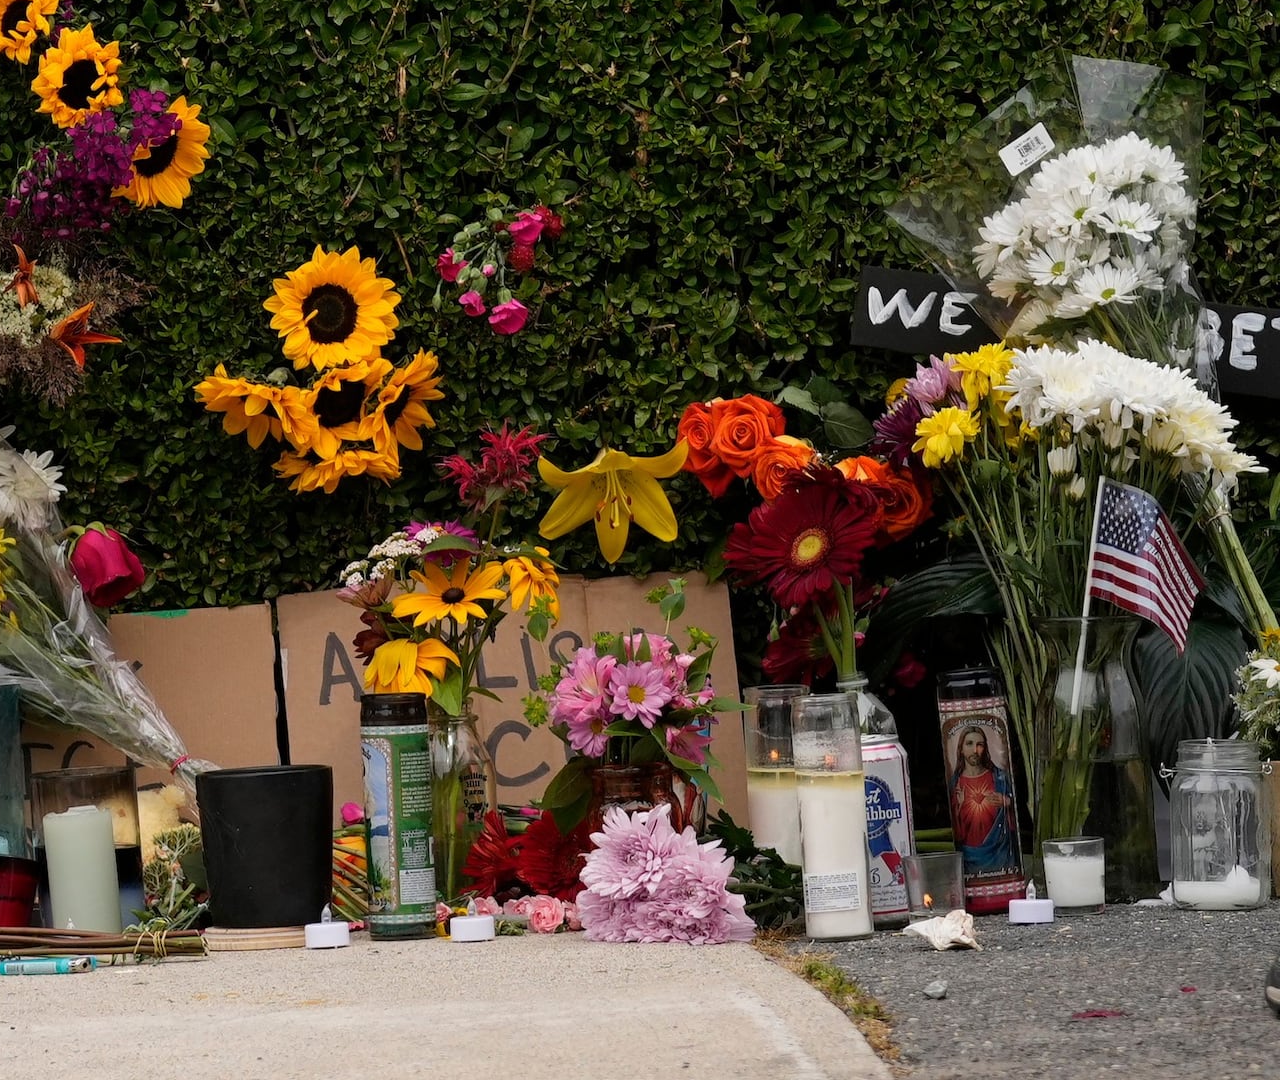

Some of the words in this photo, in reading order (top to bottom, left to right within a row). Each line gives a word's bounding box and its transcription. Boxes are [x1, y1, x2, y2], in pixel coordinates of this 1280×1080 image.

[868, 286, 978, 335] WE
[458, 772, 488, 783] Smiling
[867, 804, 901, 821] ibbon
